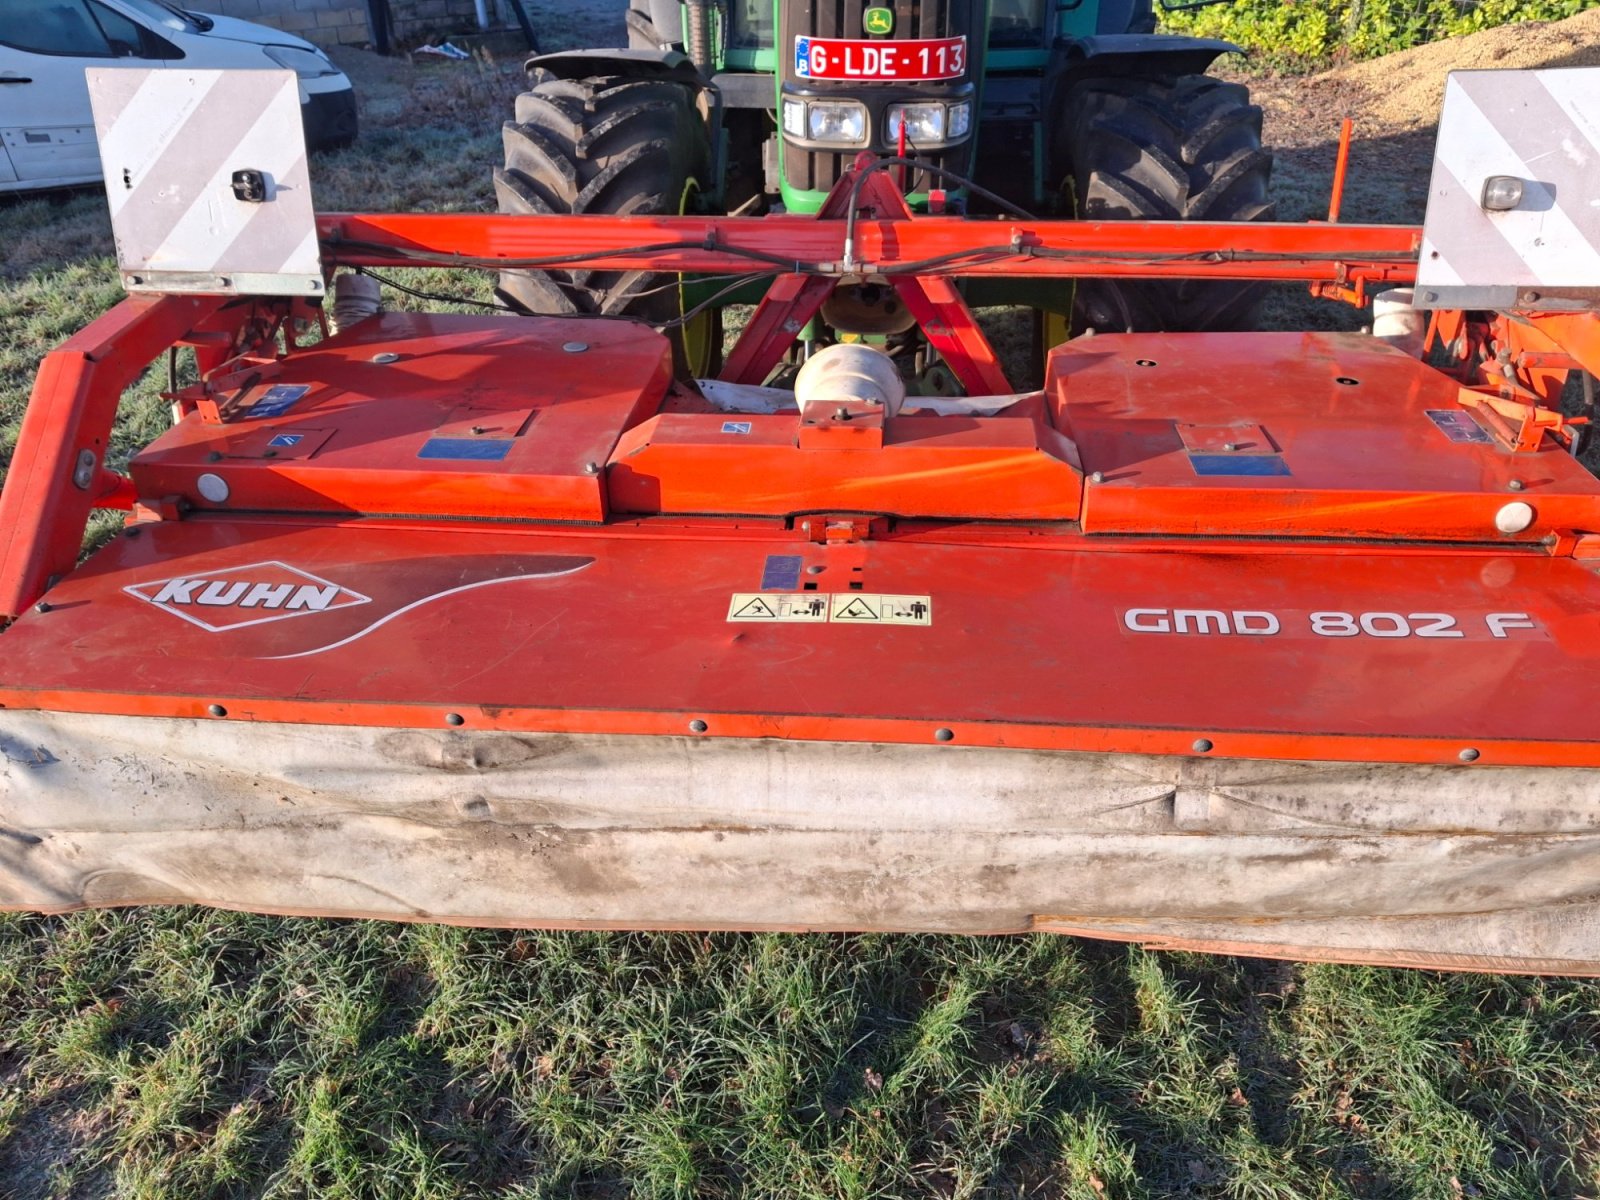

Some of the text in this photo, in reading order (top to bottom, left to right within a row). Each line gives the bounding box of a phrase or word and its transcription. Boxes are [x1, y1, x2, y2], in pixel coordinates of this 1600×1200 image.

[799, 59, 808, 72] B
[151, 579, 341, 610] KUHN
[1124, 608, 1536, 638] GMD 802 F
